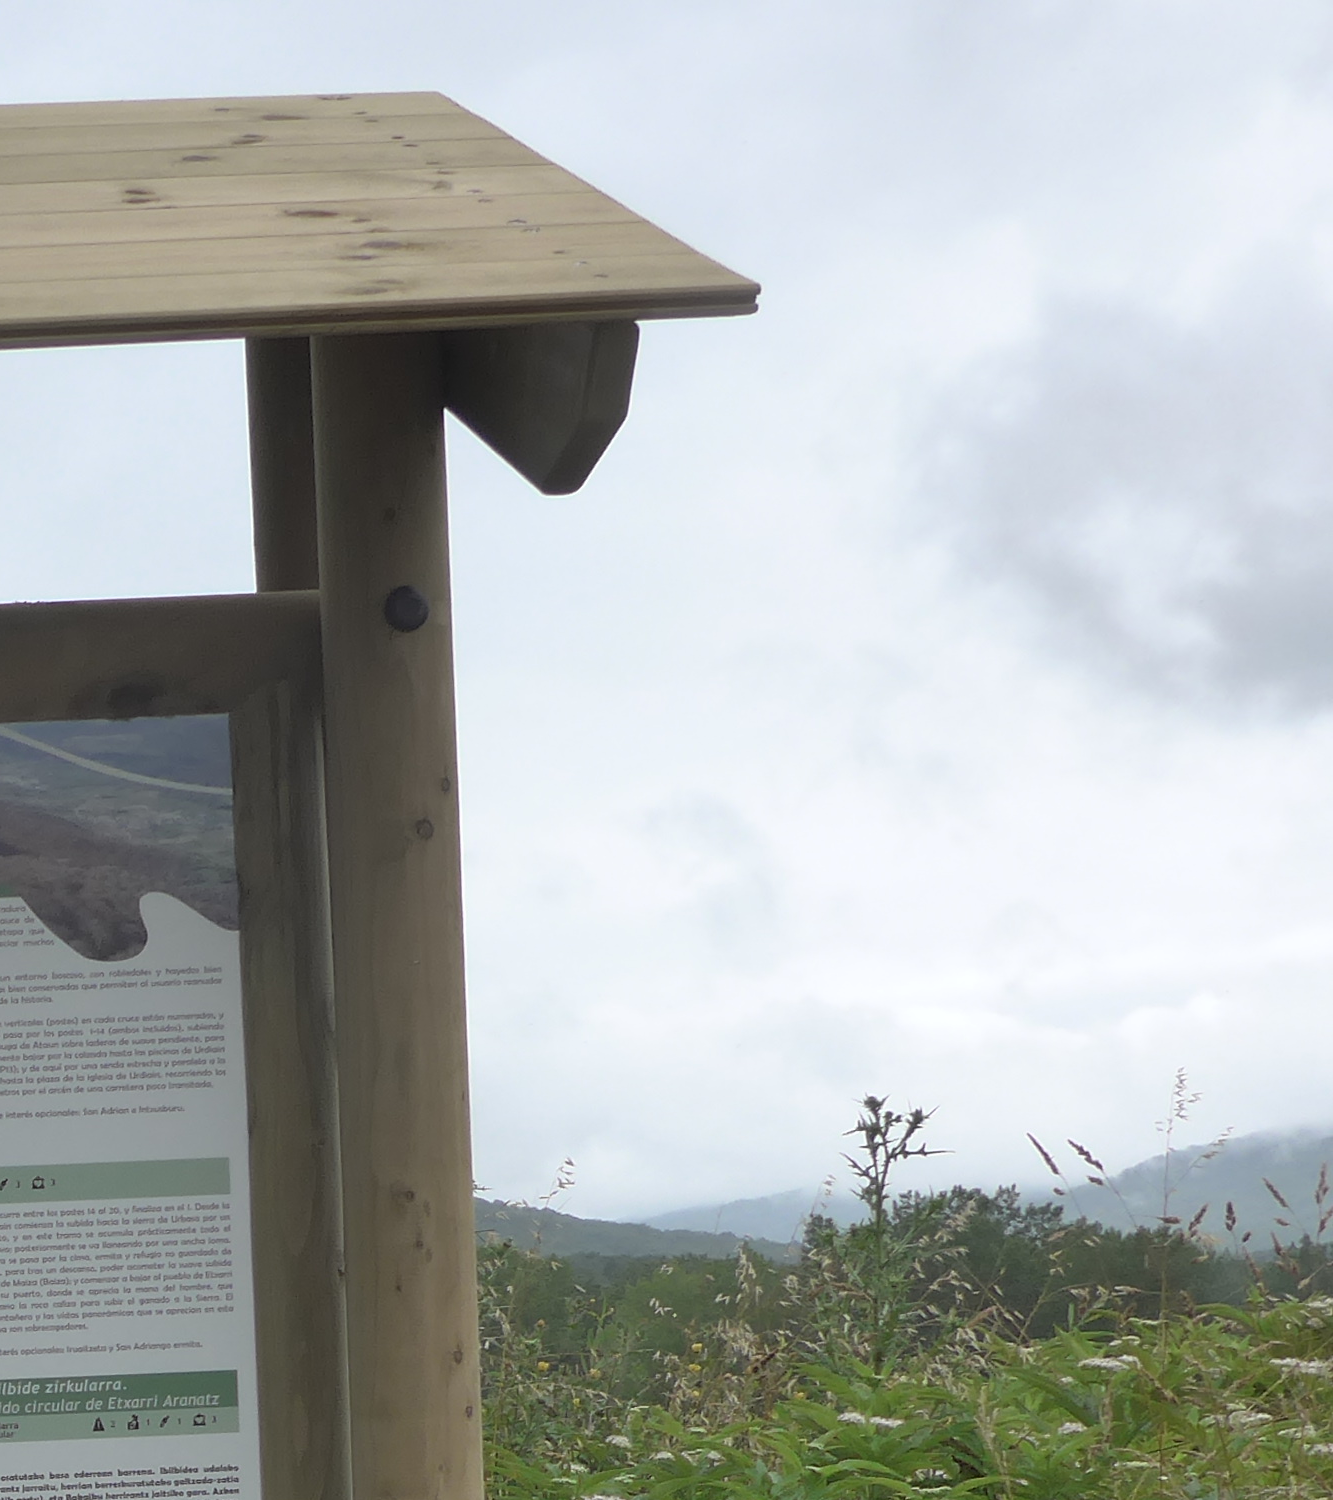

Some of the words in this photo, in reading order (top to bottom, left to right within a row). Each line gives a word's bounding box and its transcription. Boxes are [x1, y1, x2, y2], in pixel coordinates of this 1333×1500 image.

[45, 1378, 127, 1393] zirkularra.
[25, 1398, 81, 1413] circular
[85, 1397, 103, 1414] de
[107, 1395, 158, 1413] Etxarri
[162, 1393, 223, 1411] Aranatz
